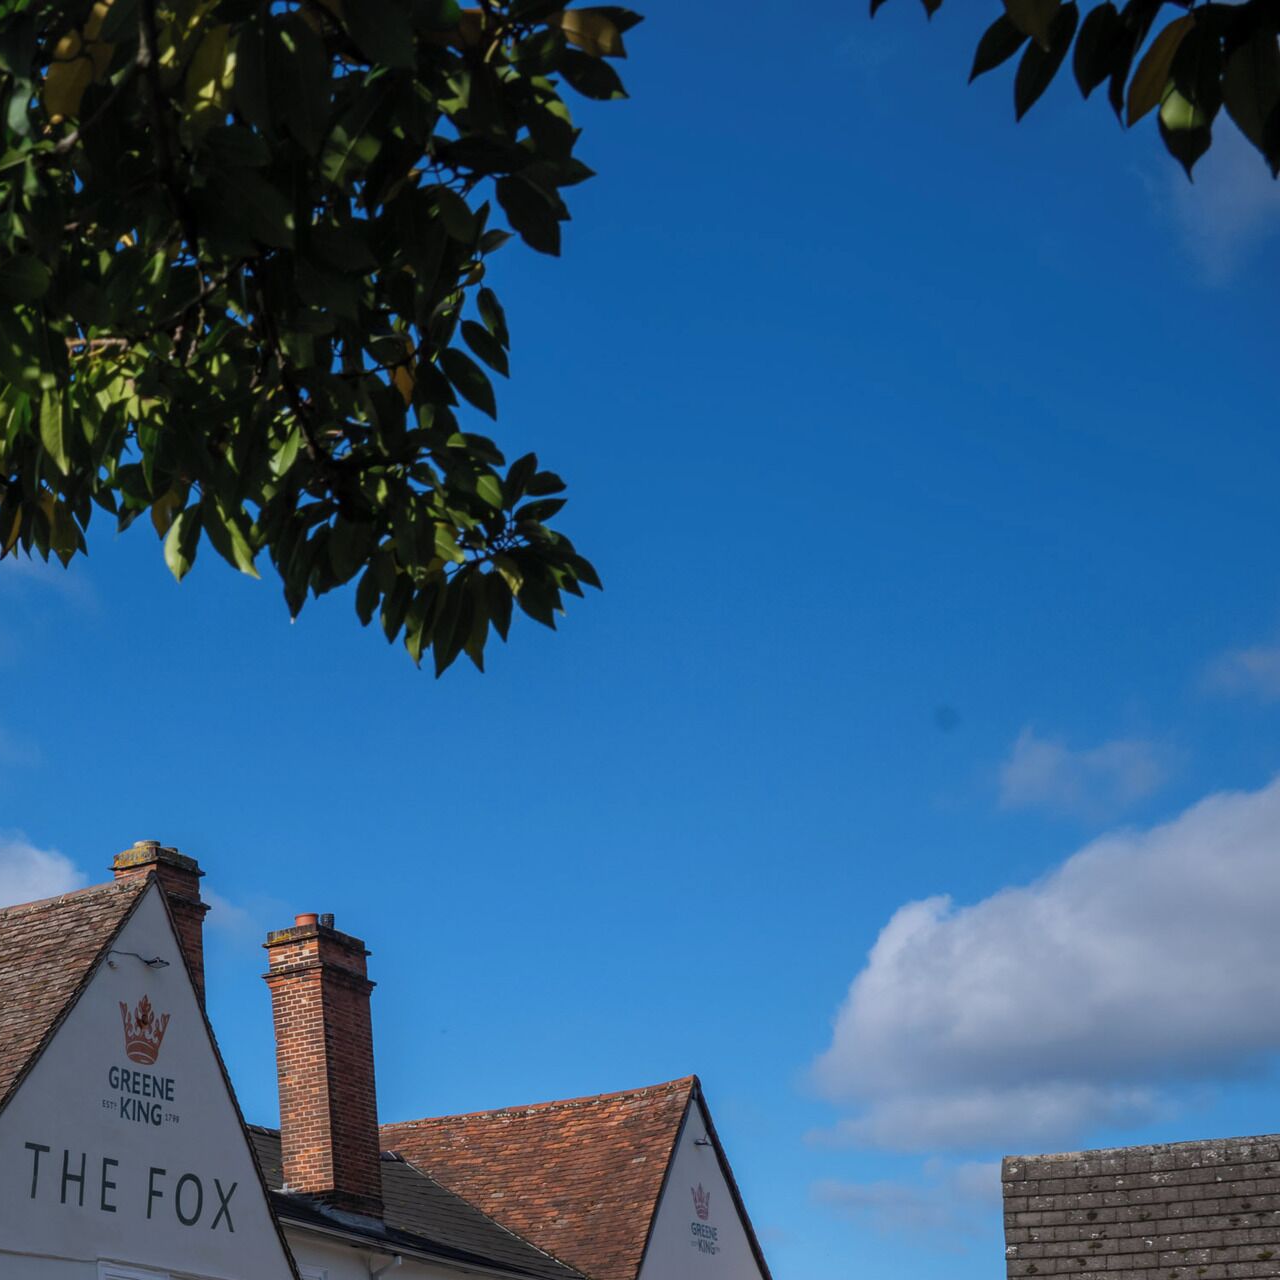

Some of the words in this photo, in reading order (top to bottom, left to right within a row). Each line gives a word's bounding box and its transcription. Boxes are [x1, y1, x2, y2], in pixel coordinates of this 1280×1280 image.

[109, 1066, 175, 1101] GREENE
[120, 1097, 162, 1126] KING
[25, 1142, 119, 1213] THE
[146, 1167, 238, 1232] FOX
